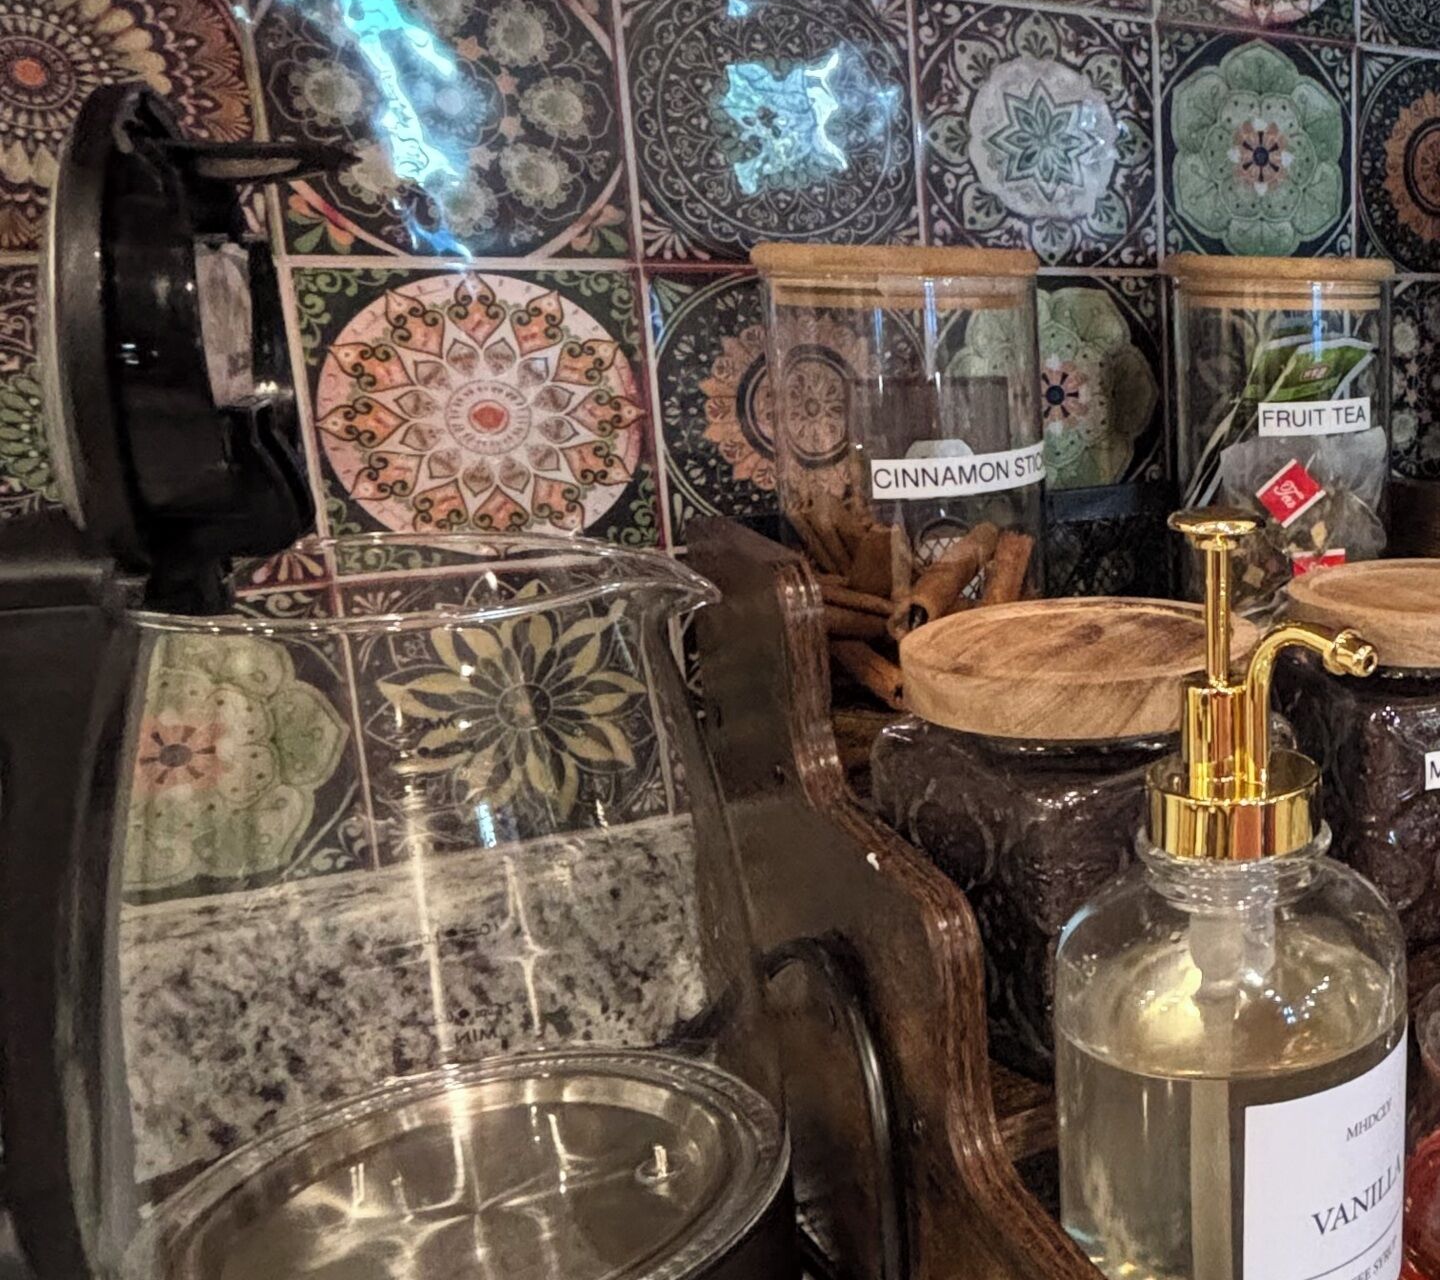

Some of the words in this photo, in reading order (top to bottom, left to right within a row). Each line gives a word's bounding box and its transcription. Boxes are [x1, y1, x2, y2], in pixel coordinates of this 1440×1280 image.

[1261, 407, 1326, 429] FRUIT
[1332, 405, 1367, 426] TEA
[873, 458, 1010, 490] CINNAMON
[1272, 479, 1305, 509] Tea
